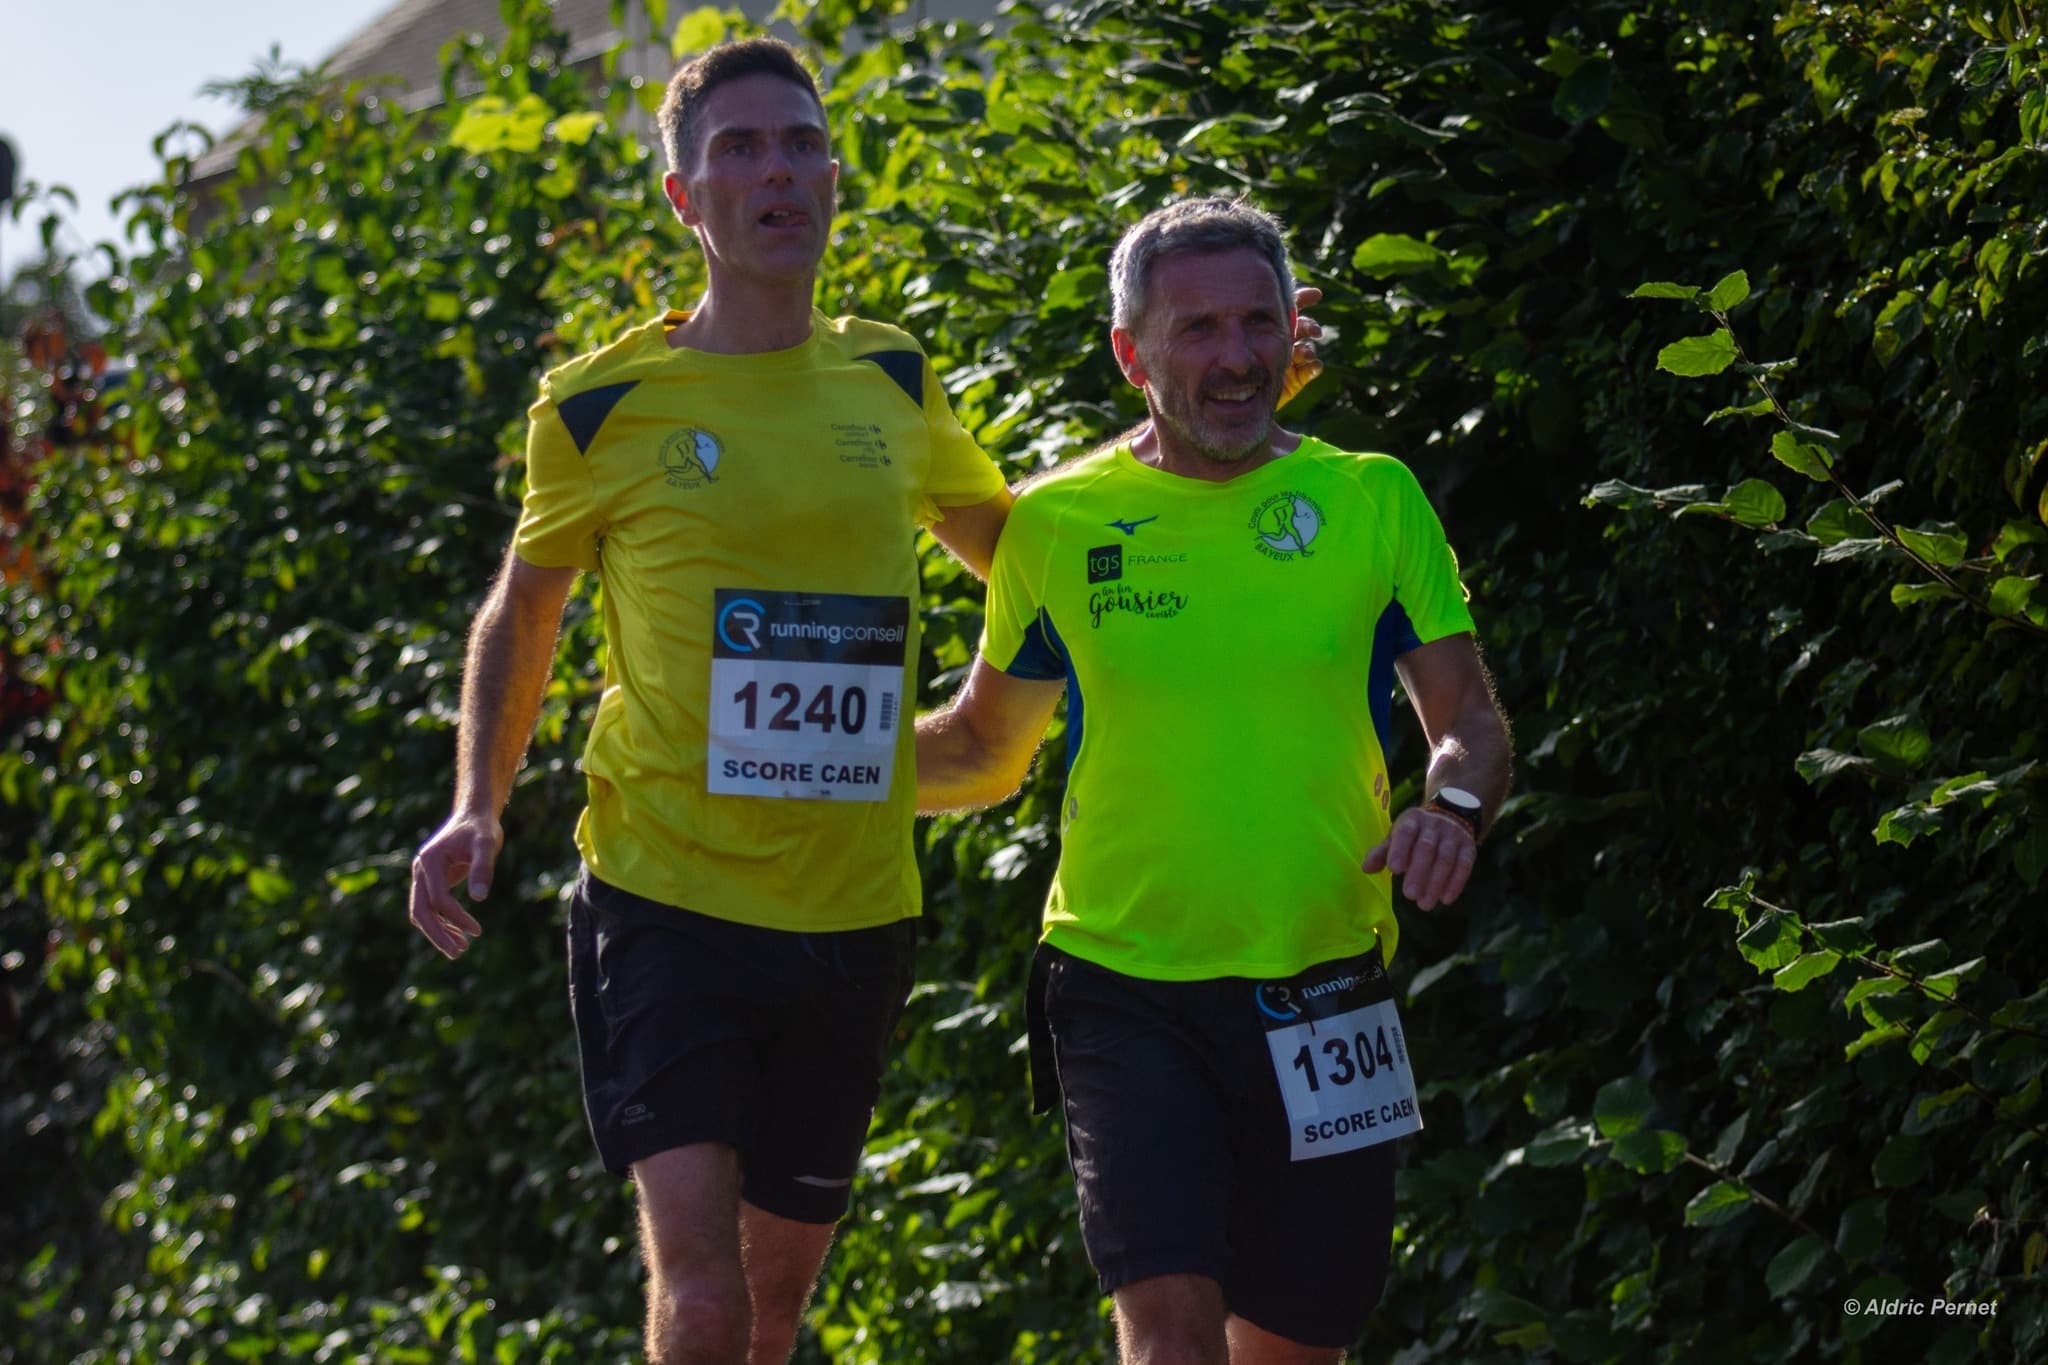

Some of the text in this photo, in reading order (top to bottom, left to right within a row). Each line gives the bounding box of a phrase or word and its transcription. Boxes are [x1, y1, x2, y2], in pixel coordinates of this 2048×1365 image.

[1255, 541, 1295, 562] BAYEUX
[1090, 553, 1121, 577] tgs
[770, 621, 904, 644] runningconseil
[733, 681, 867, 735] 1240
[723, 759, 881, 785] SCORE CAEN
[1293, 1025, 1394, 1092] 1304
[1304, 1096, 1415, 1143] SCORE CAEN
